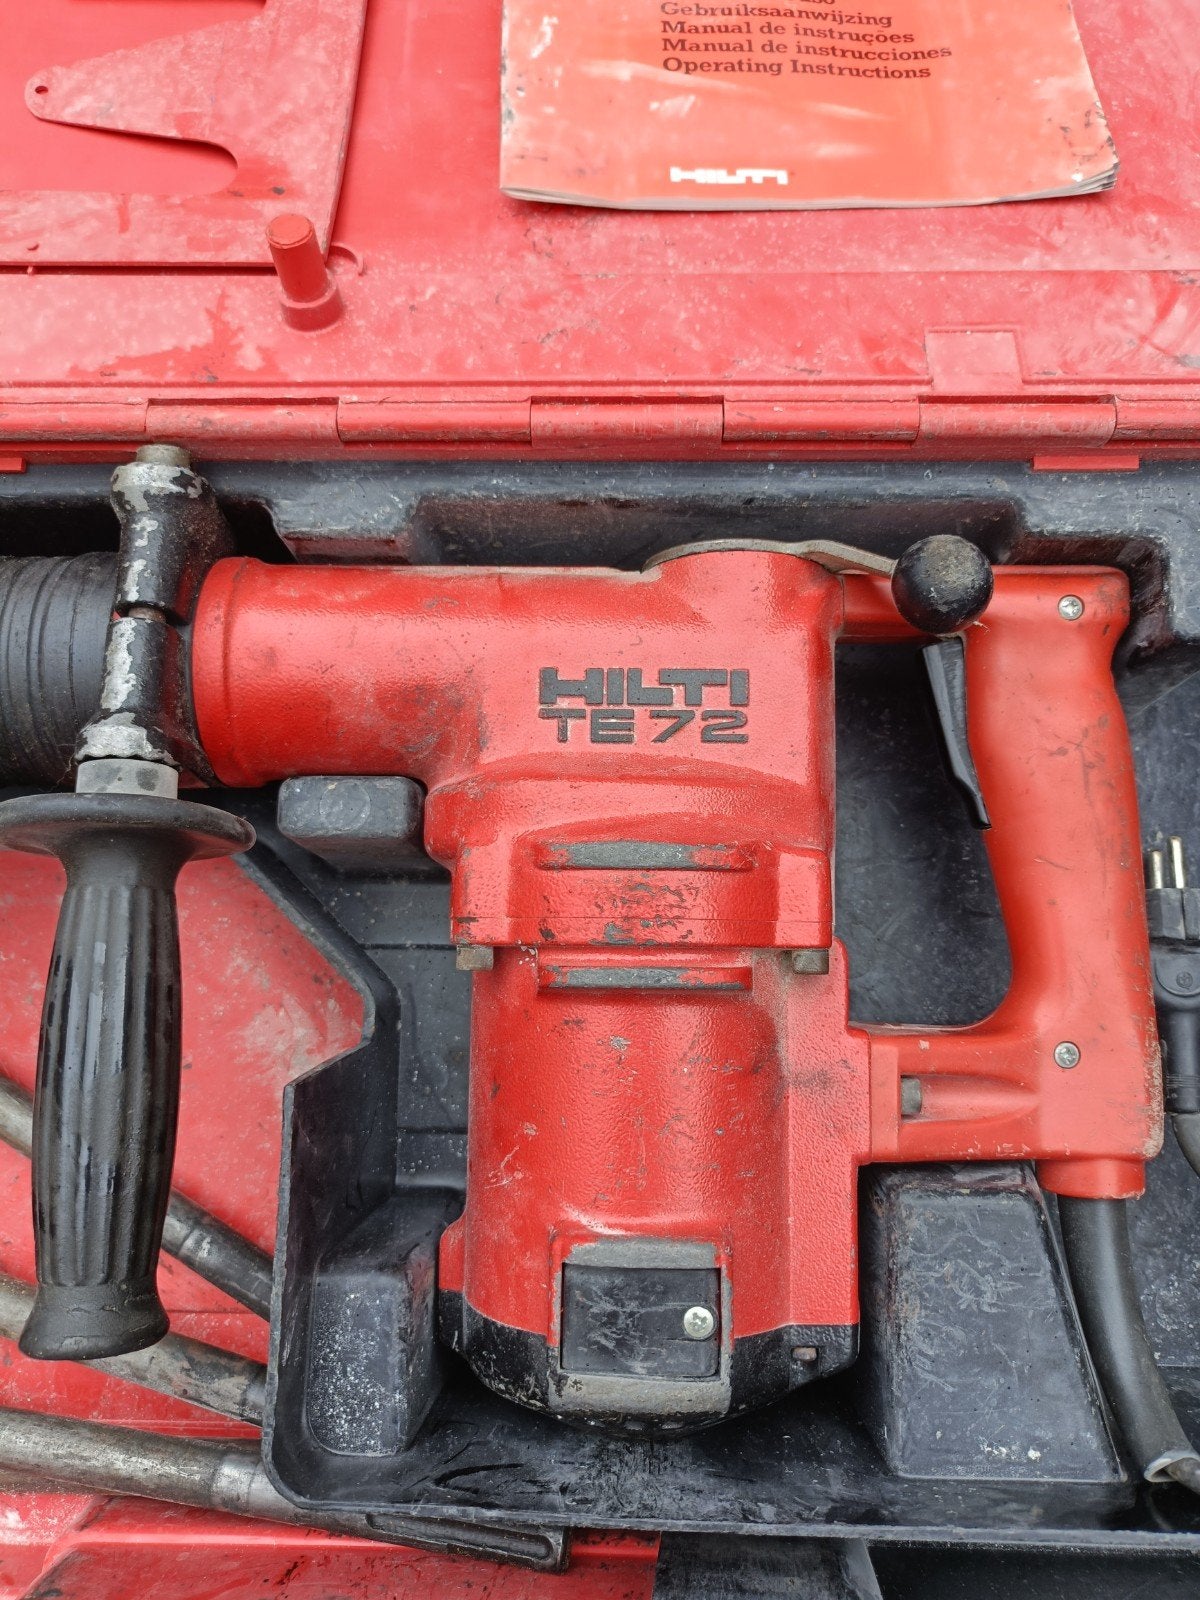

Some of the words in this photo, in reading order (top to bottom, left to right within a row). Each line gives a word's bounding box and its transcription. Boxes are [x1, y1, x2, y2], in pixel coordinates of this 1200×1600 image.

[660, 2, 893, 28] Gebruiksaanwijzing
[661, 20, 753, 34] Manual
[759, 22, 786, 35] de
[793, 23, 915, 46] instruções
[662, 38, 754, 52] Manual
[761, 40, 788, 53] de
[796, 40, 953, 61] instrucciones
[662, 57, 783, 76] Operating
[790, 59, 931, 79] Instructions
[669, 166, 789, 186] HILTI
[538, 667, 749, 706] HILTI
[538, 708, 635, 743] TE
[649, 709, 749, 744] 72
